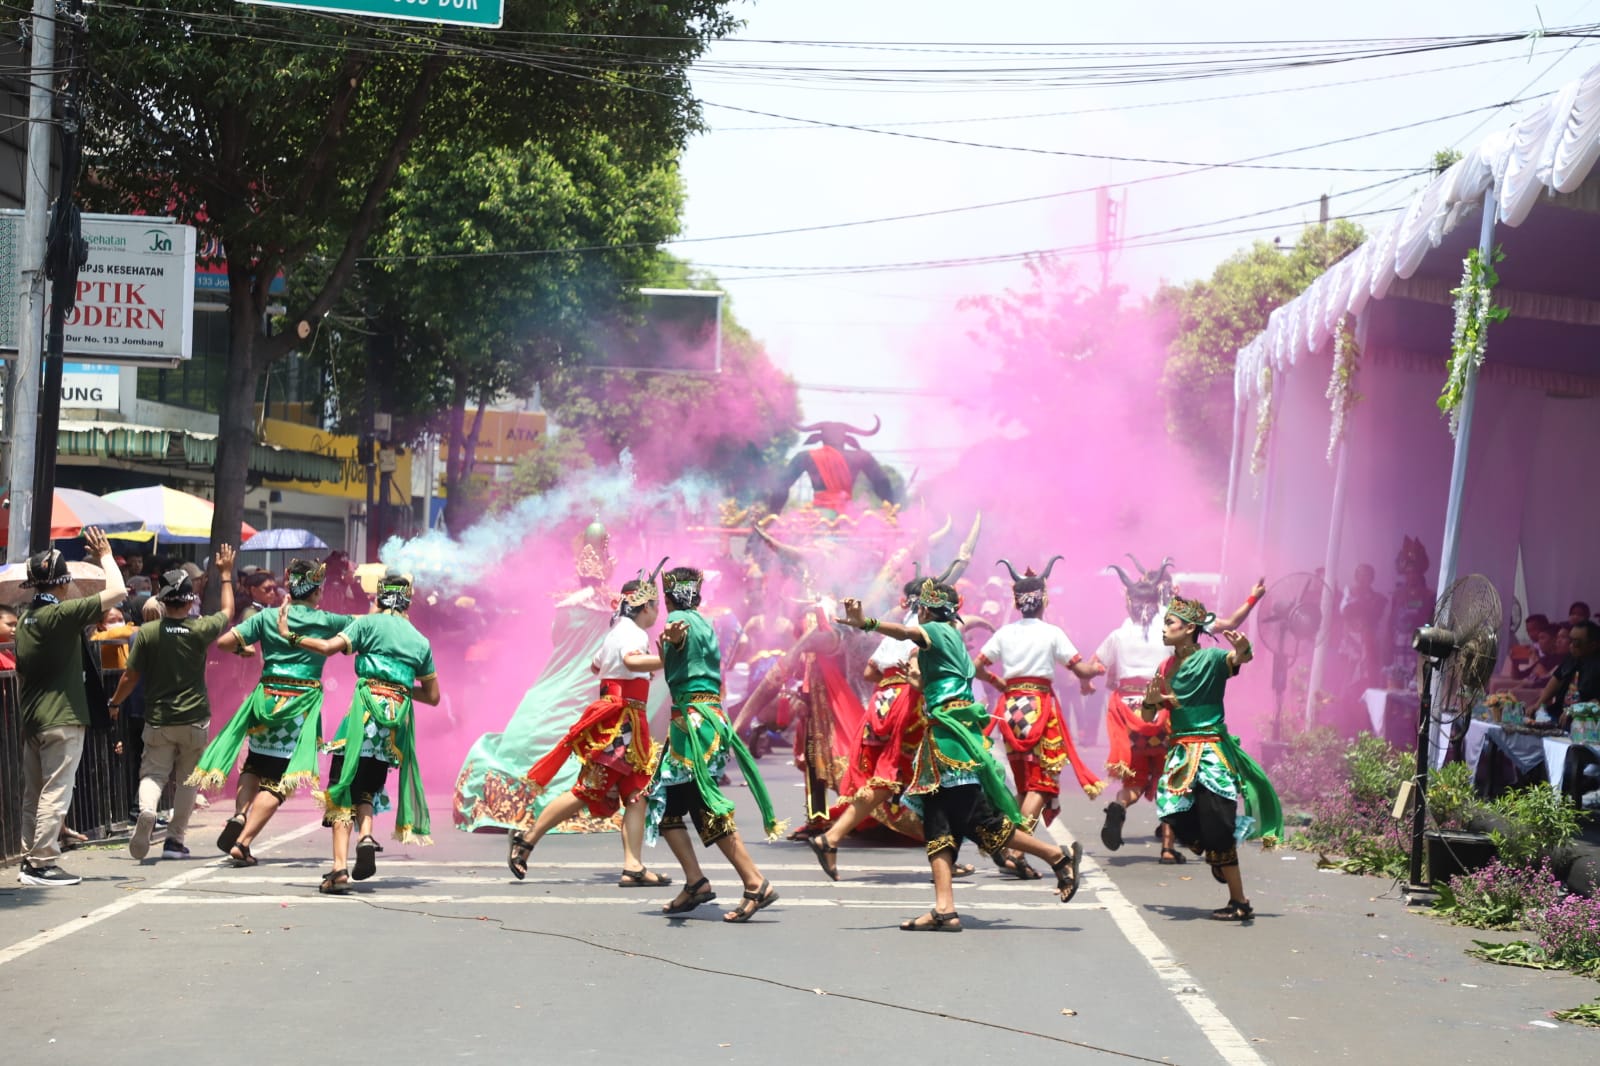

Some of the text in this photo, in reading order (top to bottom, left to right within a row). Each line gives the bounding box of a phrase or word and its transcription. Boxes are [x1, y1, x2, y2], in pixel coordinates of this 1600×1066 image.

[80, 264, 164, 276] BPJS KESEHATAN
[76, 280, 146, 305] PTIK
[65, 334, 82, 342] Dur
[122, 338, 163, 348] Jombang
[61, 388, 103, 402] UNG
